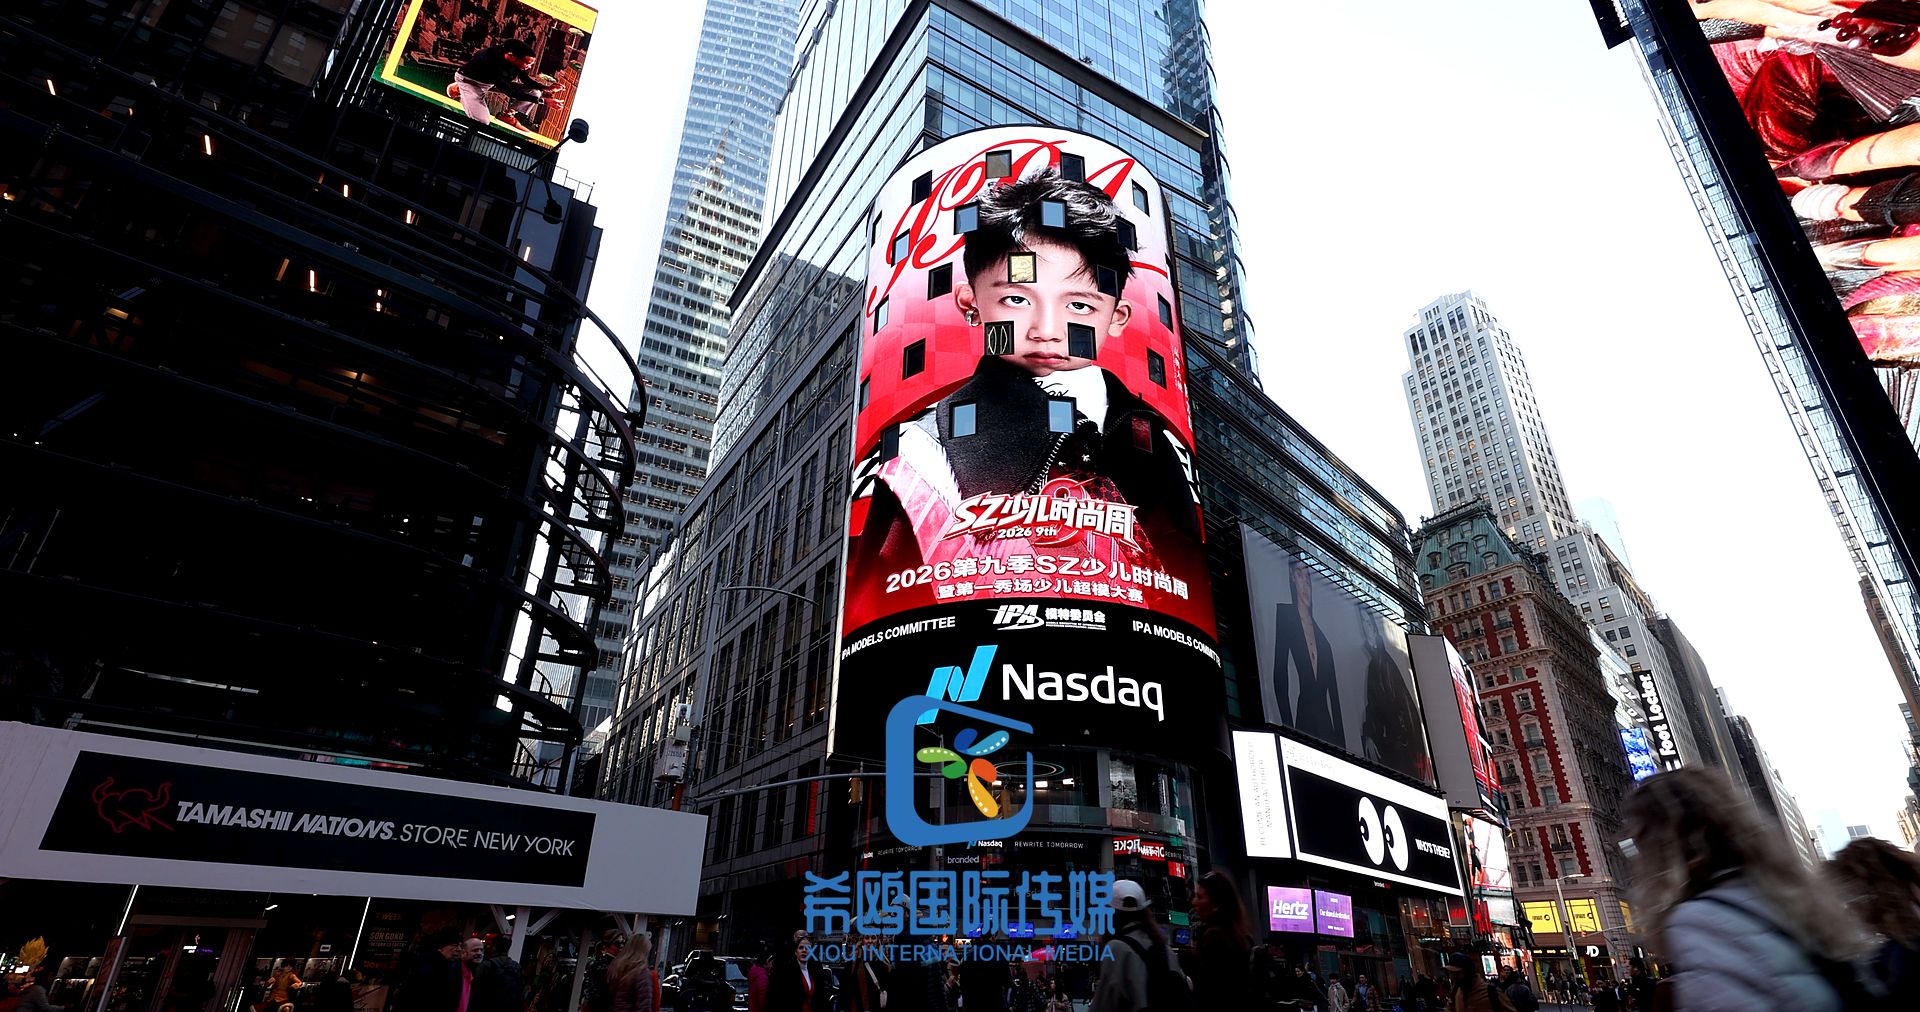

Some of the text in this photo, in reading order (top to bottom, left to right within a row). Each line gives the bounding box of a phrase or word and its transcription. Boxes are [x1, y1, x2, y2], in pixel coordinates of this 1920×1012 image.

[950, 493, 1135, 538] SZ少儿时尚周
[998, 527, 1032, 539] 2026
[1035, 527, 1058, 538] 9th
[885, 554, 1189, 600] 2026第九季SZ少儿时尚周
[936, 577, 1144, 604] 暨第一秀场少儿超模大赛
[991, 604, 1042, 627] IPA
[1045, 607, 1106, 624] 模特委员会
[851, 631, 884, 654] MODELS
[884, 616, 956, 640] COMMITTEE
[1132, 620, 1153, 635] IPA
[1153, 624, 1193, 647] MODELS
[1002, 663, 1165, 721] Nasdaq
[1639, 673, 1677, 756] Foot Locker
[176, 801, 293, 831] TAMASHII
[400, 823, 469, 849] STORE
[473, 830, 520, 851] NEW
[523, 835, 575, 857] YORK
[978, 840, 1003, 848] Nasdaq
[947, 855, 980, 864] branded
[1272, 899, 1310, 916] Hertz
[1585, 945, 1600, 958] JD
